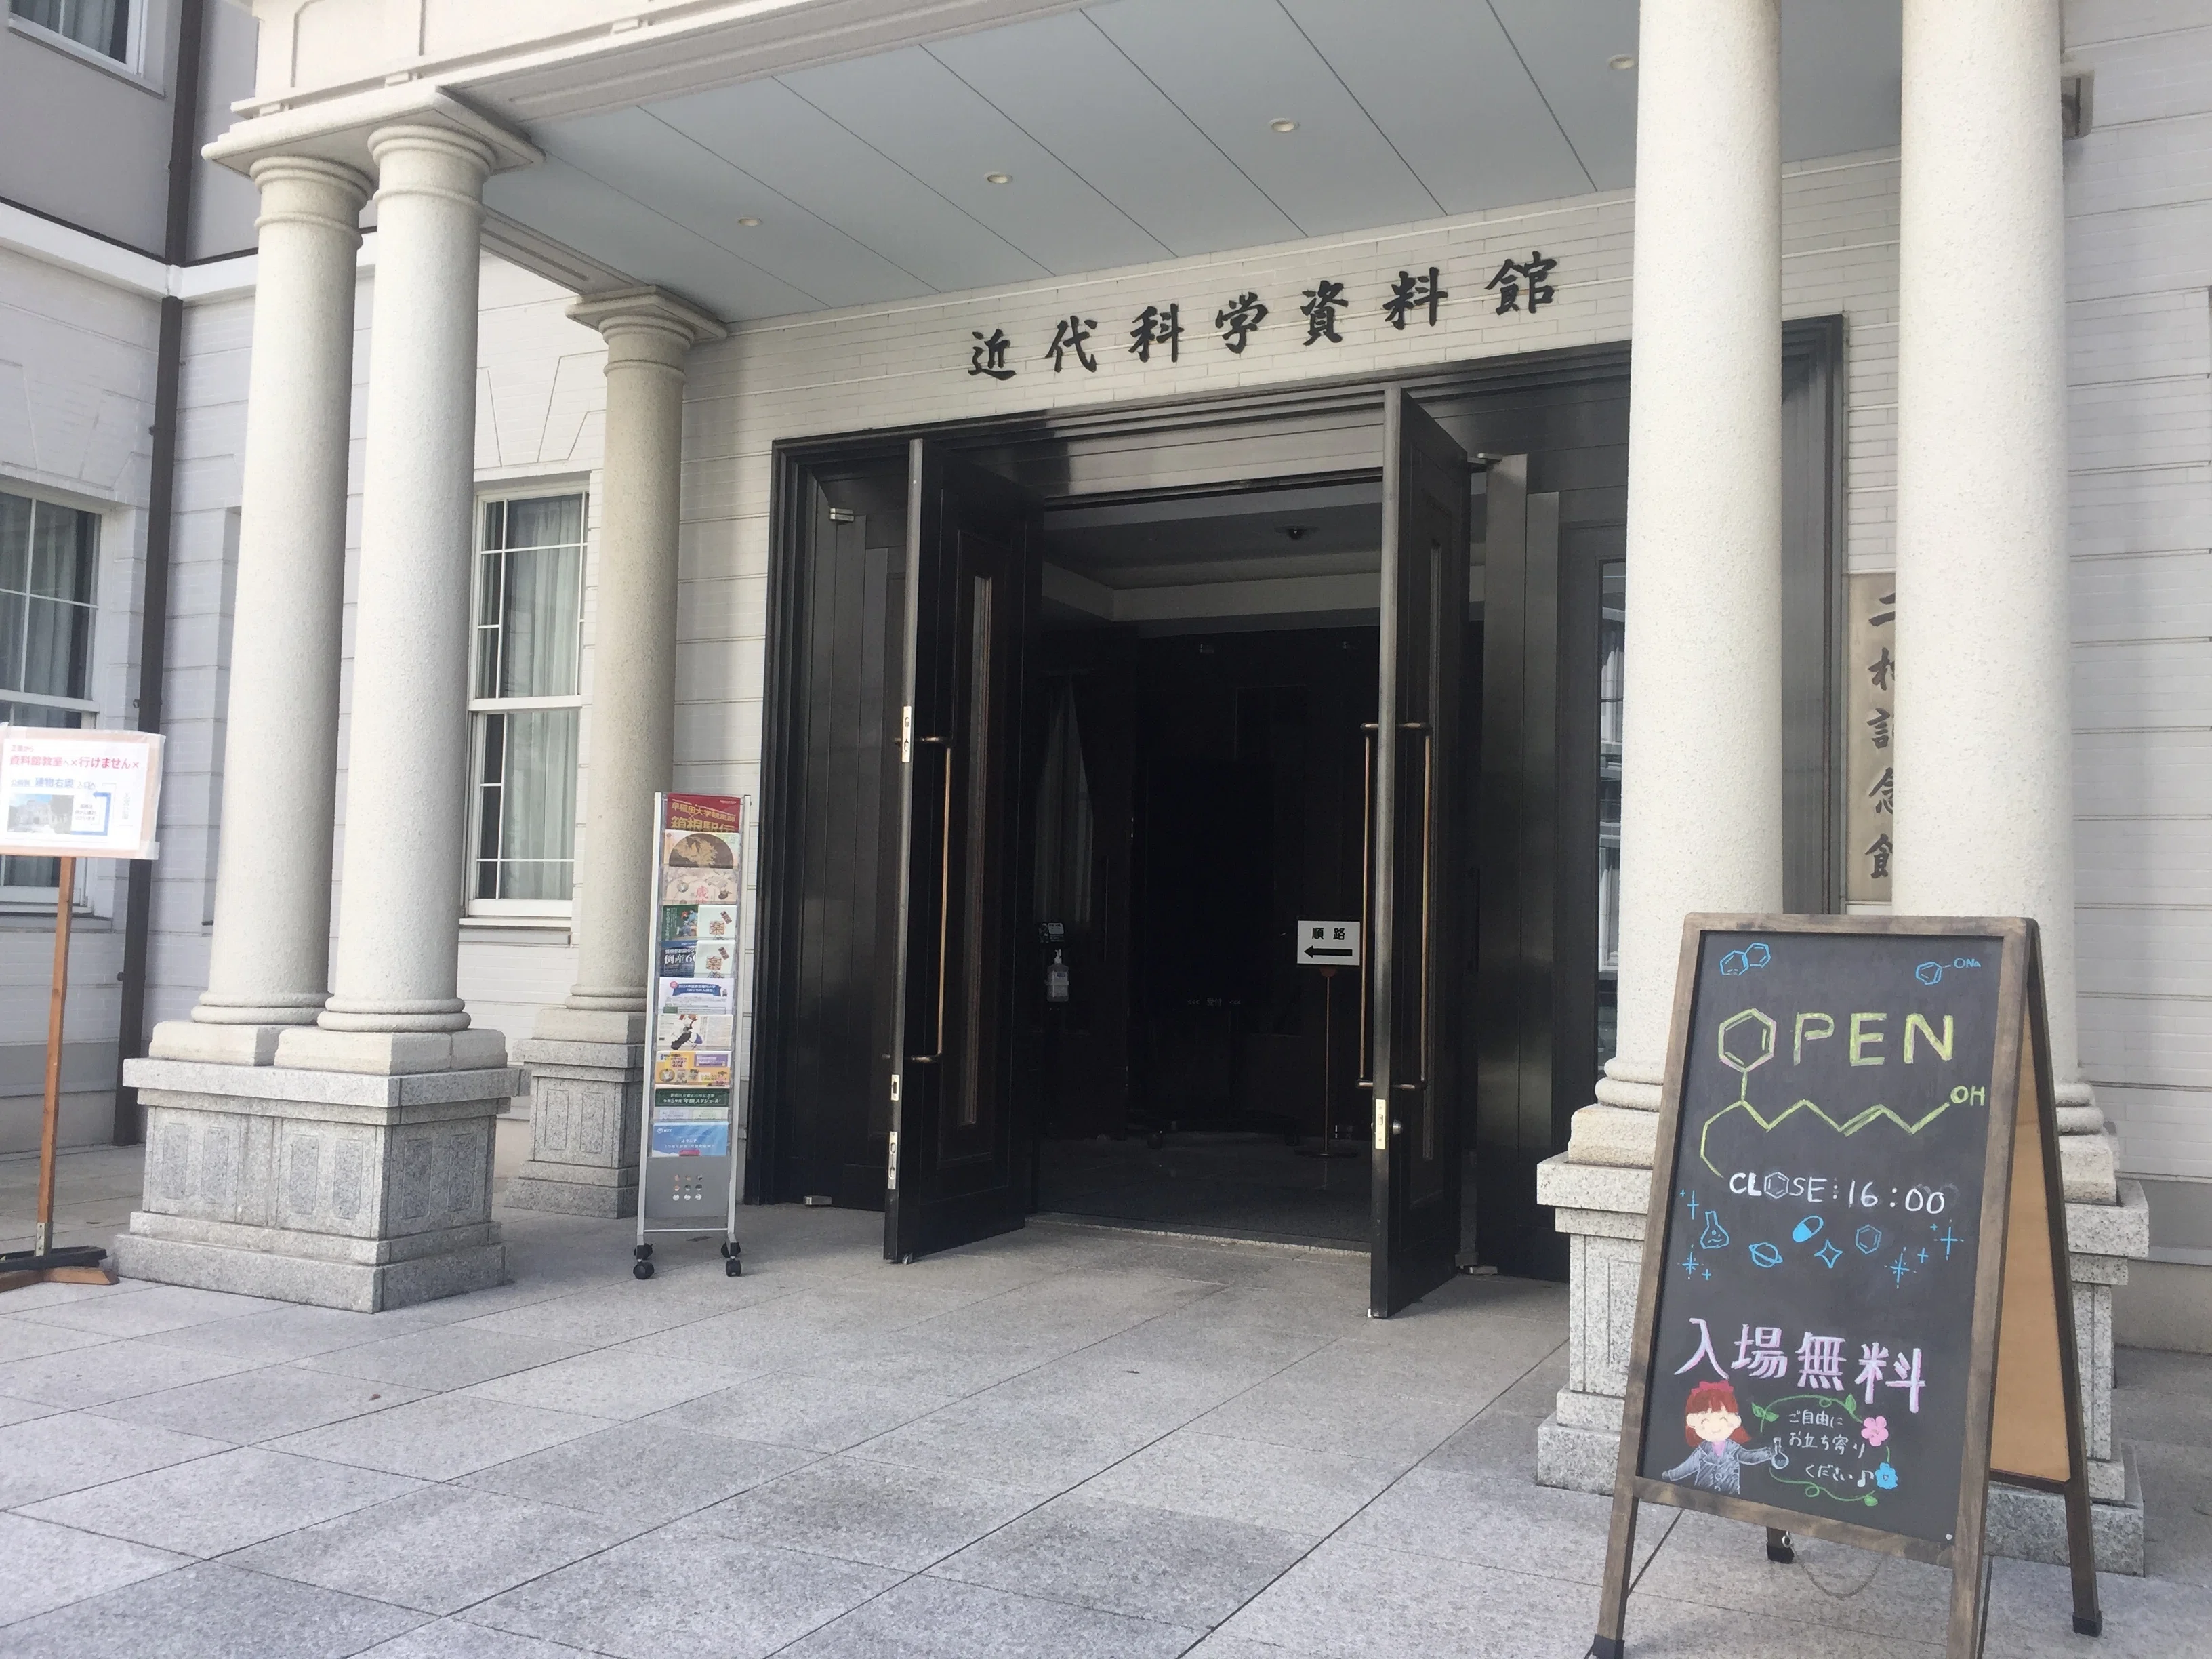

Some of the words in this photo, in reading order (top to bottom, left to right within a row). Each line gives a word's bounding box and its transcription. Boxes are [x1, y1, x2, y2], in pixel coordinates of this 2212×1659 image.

[968, 251, 1558, 381] 近代科学資料館
[1312, 927, 1345, 940] 順路
[1718, 1008, 1955, 1073] OPEN
[1950, 1085, 1986, 1107] OH
[1673, 1317, 1926, 1414] 入場無料
[1788, 1409, 1844, 1428] ご自由に
[1789, 1431, 1865, 1459] お立ち寄り
